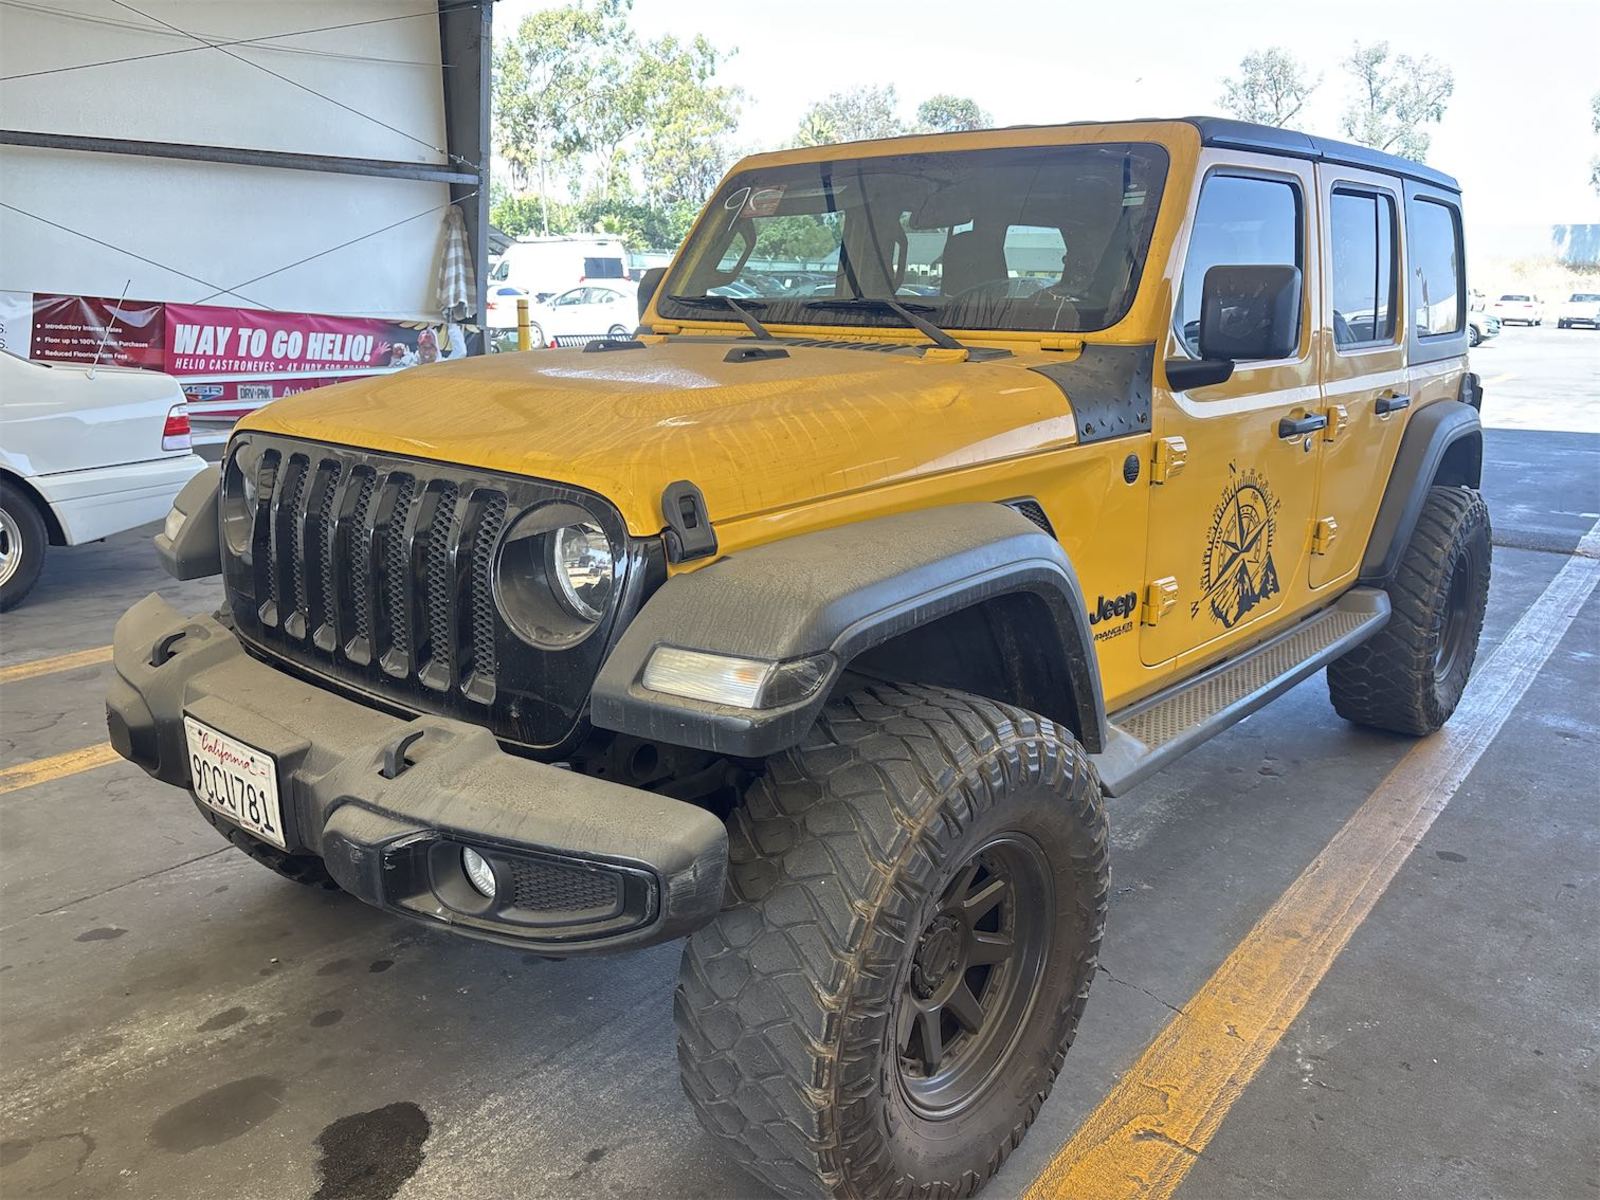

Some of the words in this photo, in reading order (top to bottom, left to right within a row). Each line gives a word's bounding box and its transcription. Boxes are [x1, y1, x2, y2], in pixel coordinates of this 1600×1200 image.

[45, 323, 81, 333] Introductory
[45, 336, 60, 344] Floor
[80, 338, 95, 346] 100%
[118, 340, 148, 348] Purchases
[173, 324, 233, 356] WAY
[237, 328, 268, 358] TO
[271, 330, 303, 359] GO
[306, 332, 374, 362] HELIO!
[45, 350, 72, 358] Reduced
[114, 352, 128, 360] Fees
[174, 358, 205, 370] HELIO
[208, 359, 275, 372] CASTRONEVES
[1089, 591, 1137, 625] Jeep
[201, 732, 257, 776] California
[193, 754, 274, 833] 9CCU781
